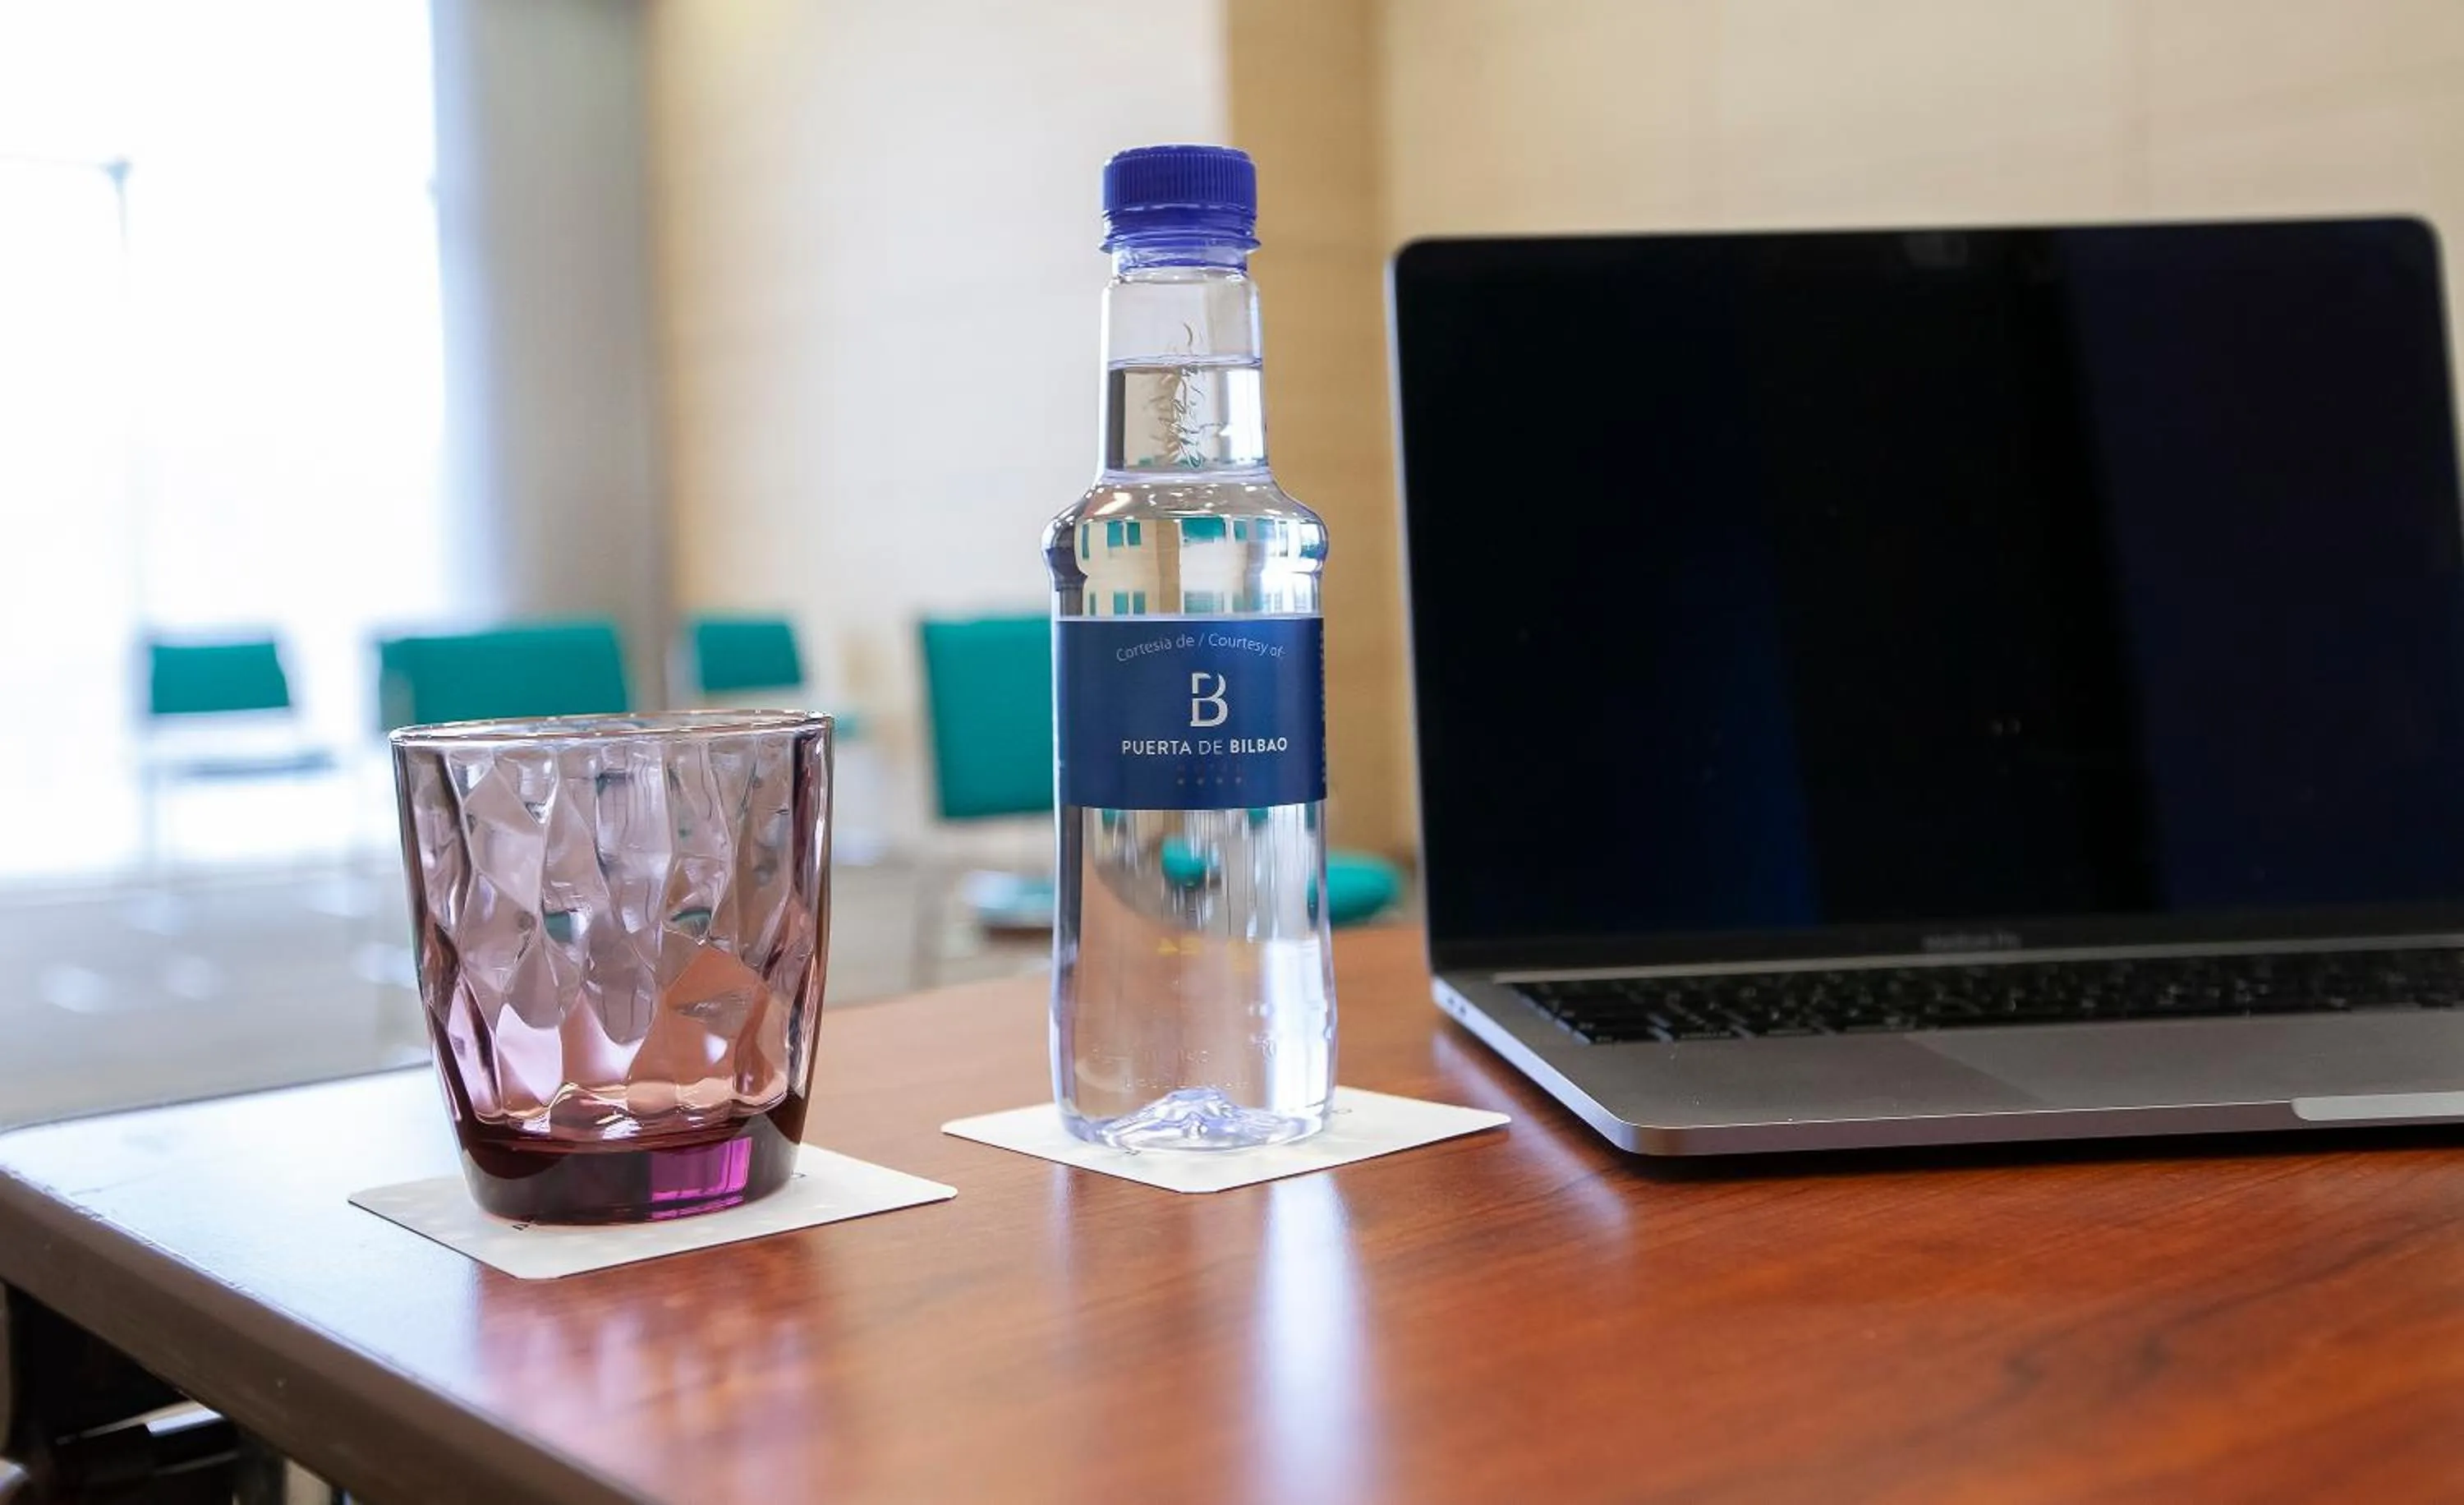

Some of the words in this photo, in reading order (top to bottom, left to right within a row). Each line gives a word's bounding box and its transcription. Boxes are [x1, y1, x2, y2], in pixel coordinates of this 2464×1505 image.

[1175, 634, 1195, 649] de
[1208, 633, 1269, 656] Courtesy
[1189, 671, 1229, 728] B
[1122, 739, 1192, 755] PUERTA
[1198, 739, 1223, 755] DE
[1230, 736, 1288, 753] BILBAO
